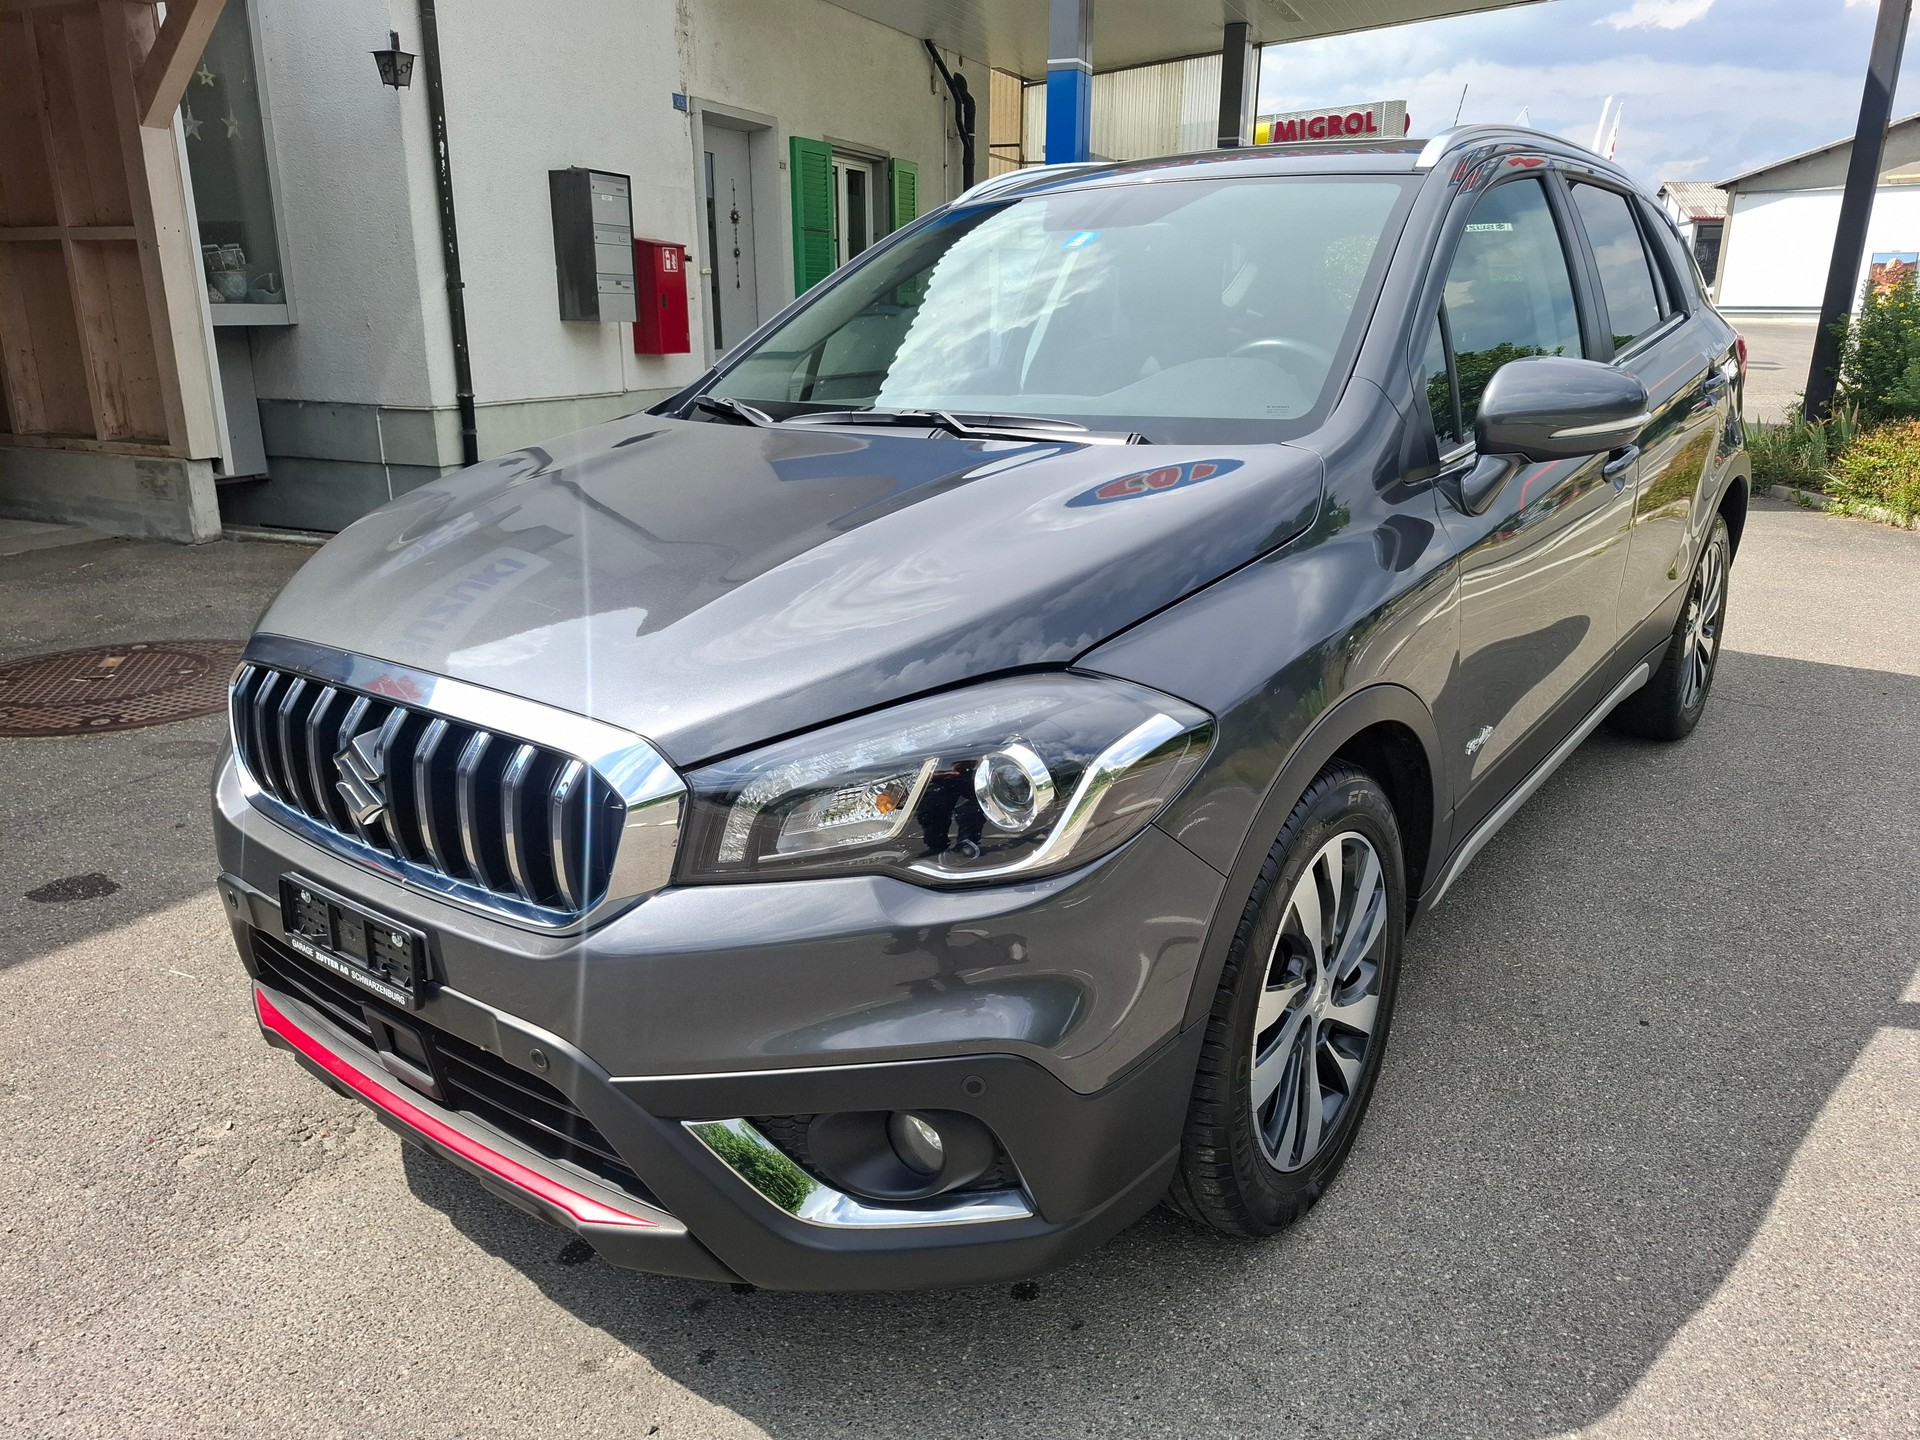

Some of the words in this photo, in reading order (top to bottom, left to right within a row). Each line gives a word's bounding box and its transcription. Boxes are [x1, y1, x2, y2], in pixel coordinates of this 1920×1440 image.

[1273, 111, 1377, 143] MIGROL
[292, 938, 314, 957] GARAGE
[315, 951, 339, 971] ZUTTER
[340, 964, 349, 976] AG
[351, 970, 406, 1005] SCHWARZENBURG
